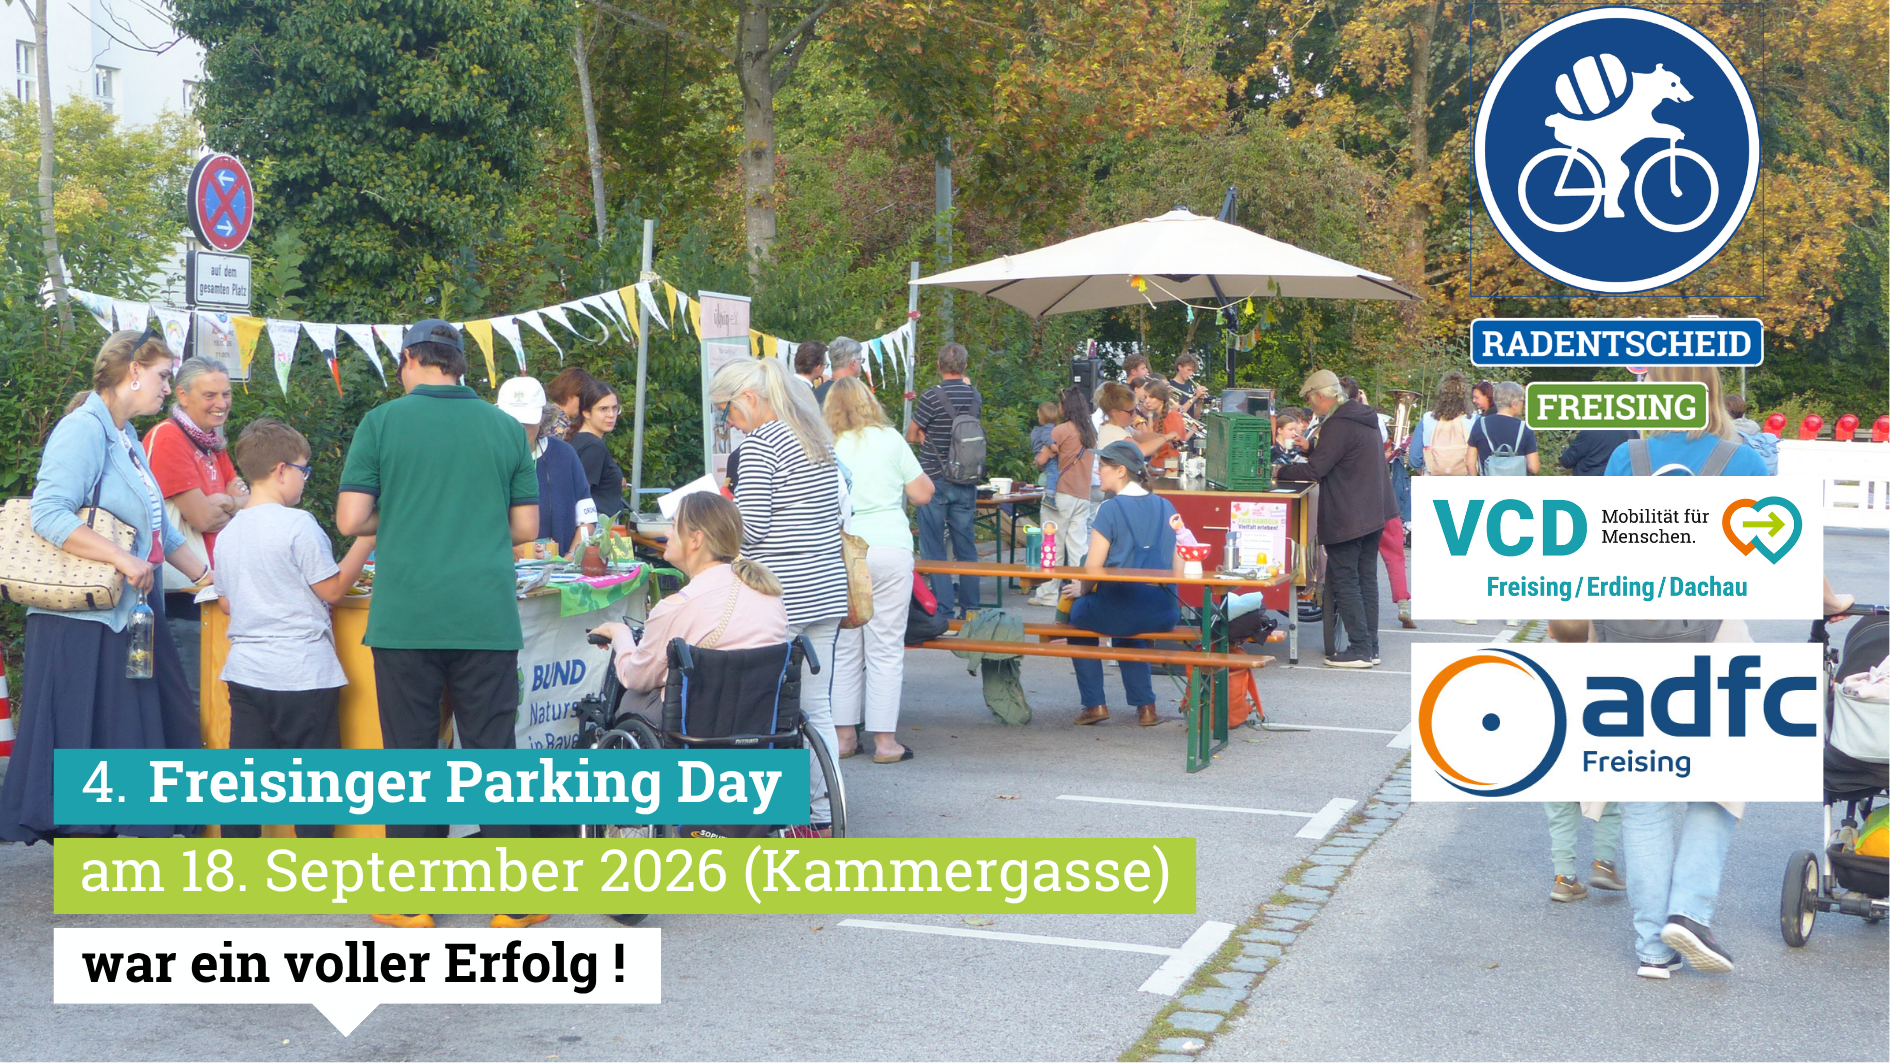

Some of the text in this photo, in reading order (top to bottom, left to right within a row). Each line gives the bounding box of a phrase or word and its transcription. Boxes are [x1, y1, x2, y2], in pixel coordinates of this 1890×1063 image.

[210, 264, 237, 278] auf dem
[199, 283, 247, 297] gesamten Platz
[531, 659, 587, 692] BUND
[529, 700, 580, 727] Naturs
[545, 733, 580, 750] Baye
